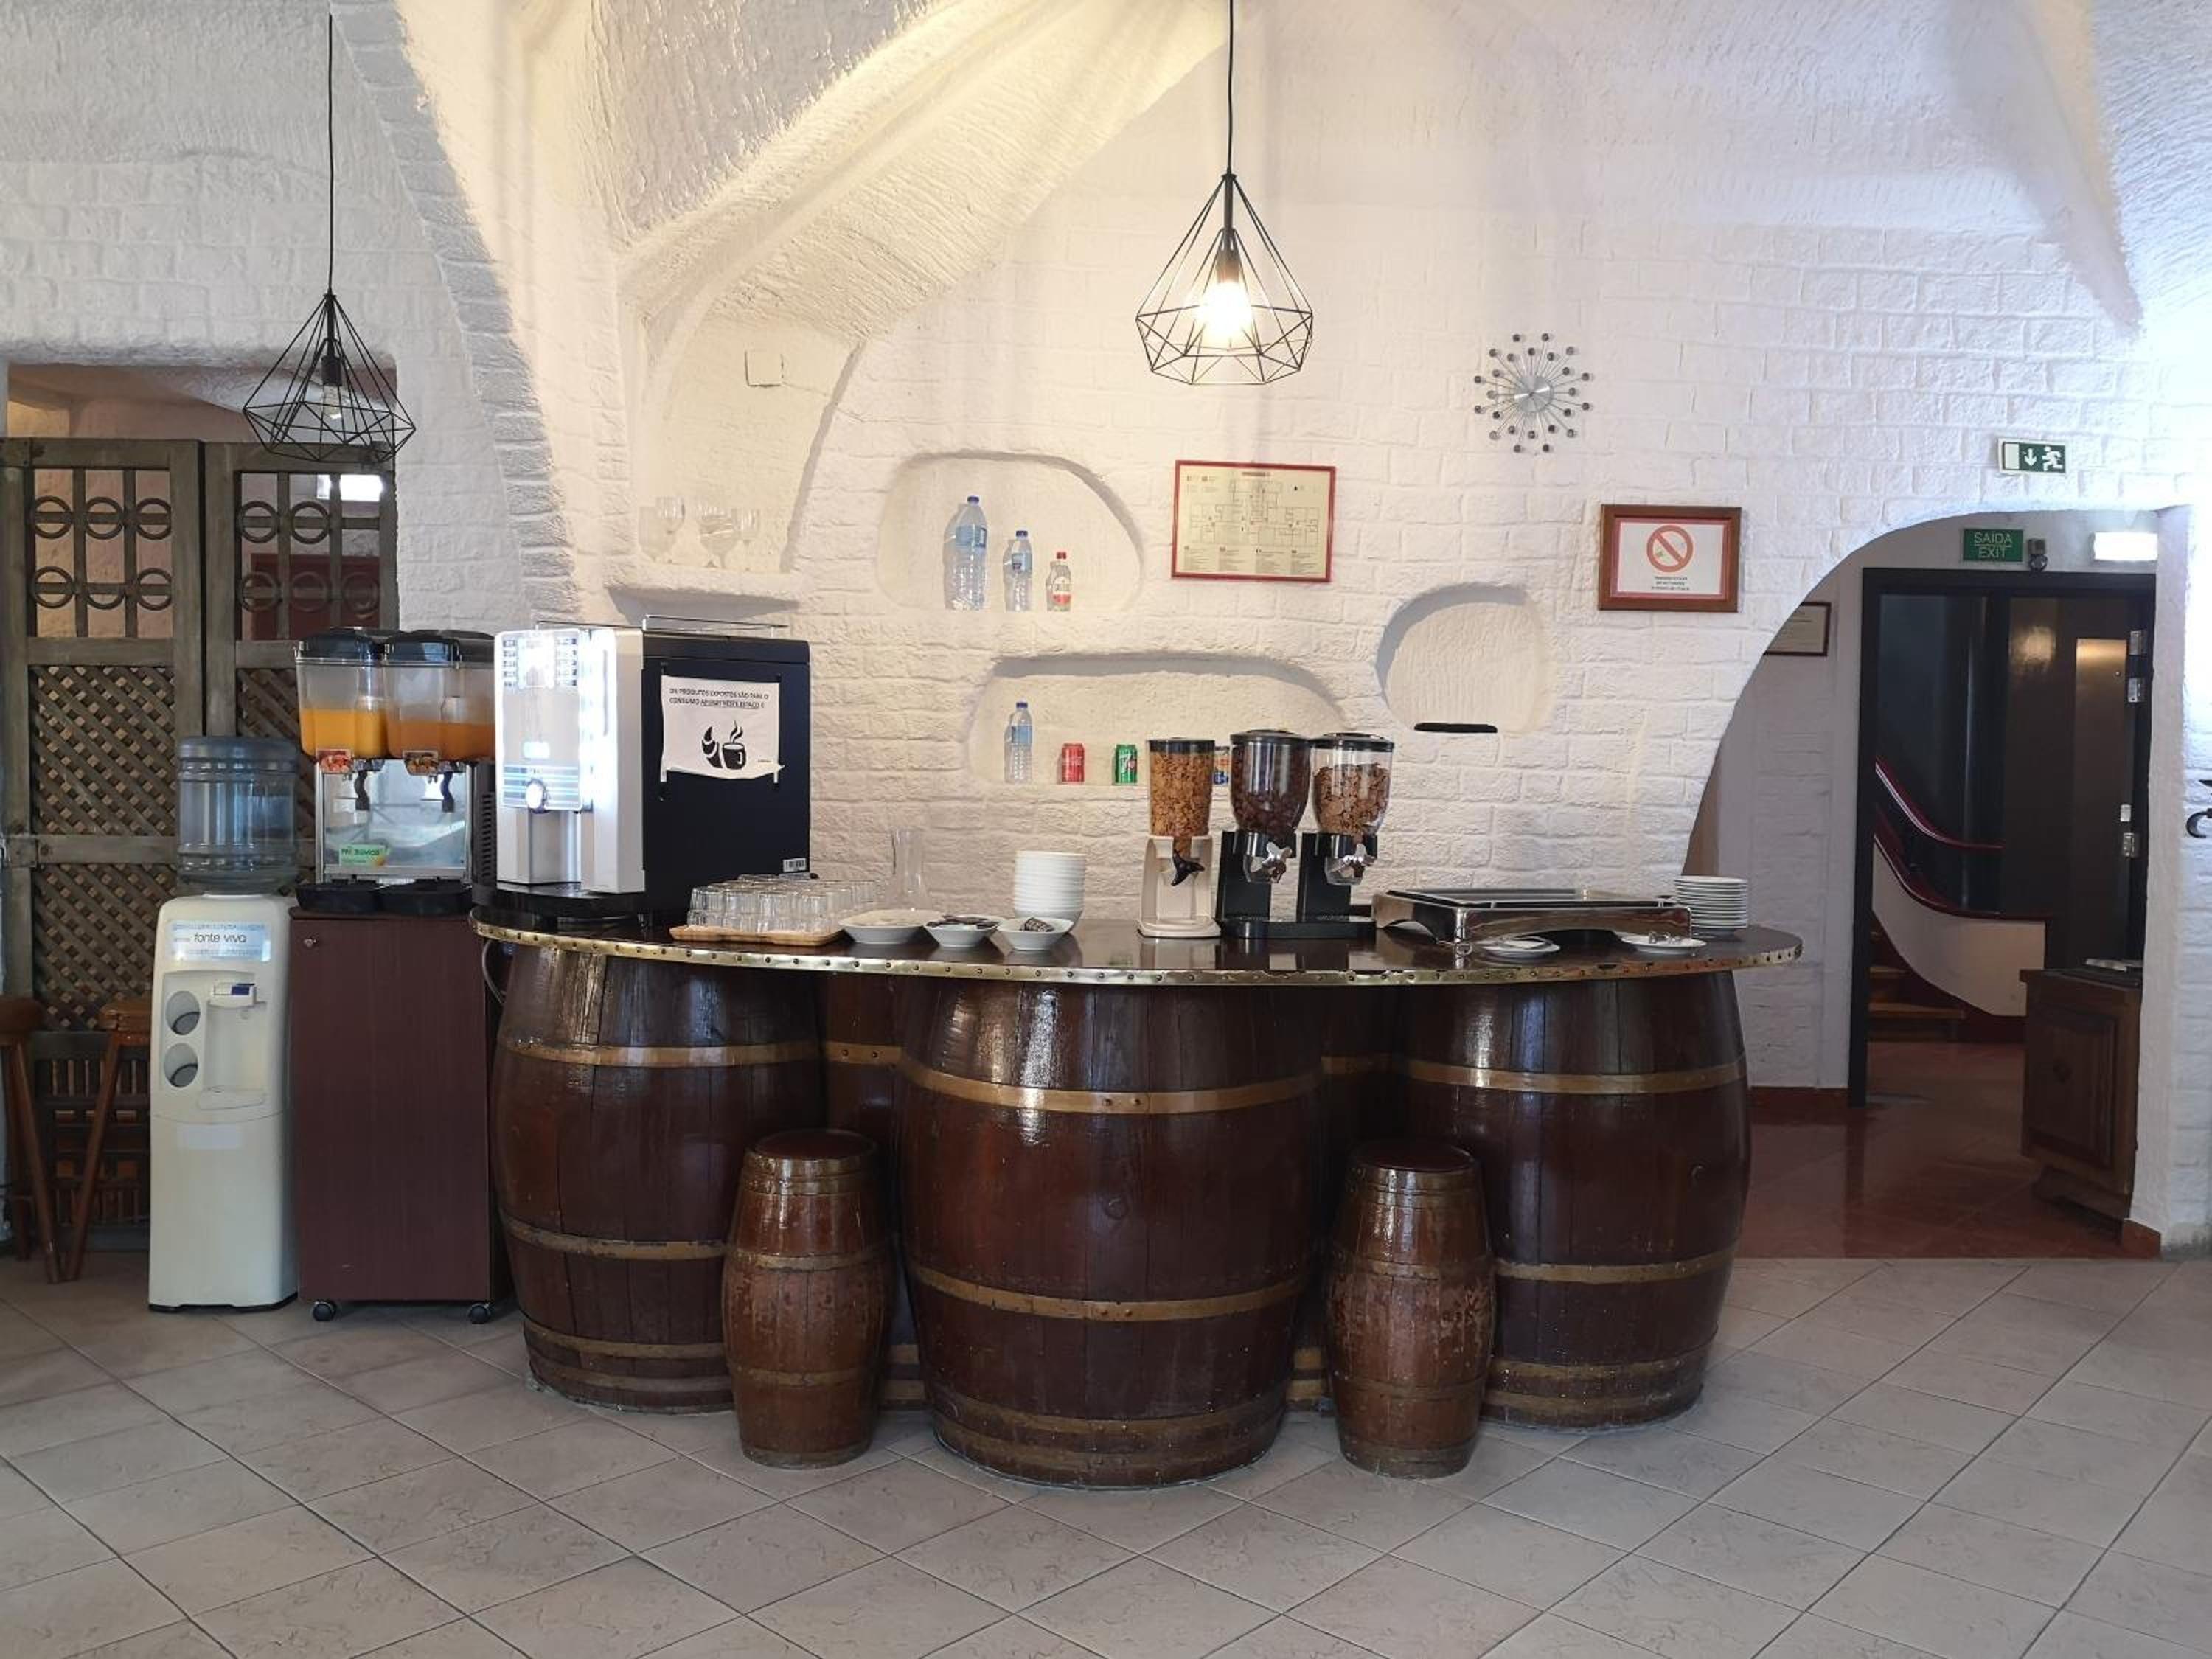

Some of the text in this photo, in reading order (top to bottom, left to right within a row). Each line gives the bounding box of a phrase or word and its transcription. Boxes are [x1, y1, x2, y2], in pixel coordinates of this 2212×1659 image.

[1978, 546, 2006, 558] EXIT
[679, 689, 709, 697] PRODUTOS
[669, 697, 700, 705] CONSUMO
[194, 931, 220, 943] fonte
[223, 933, 247, 943] viva
